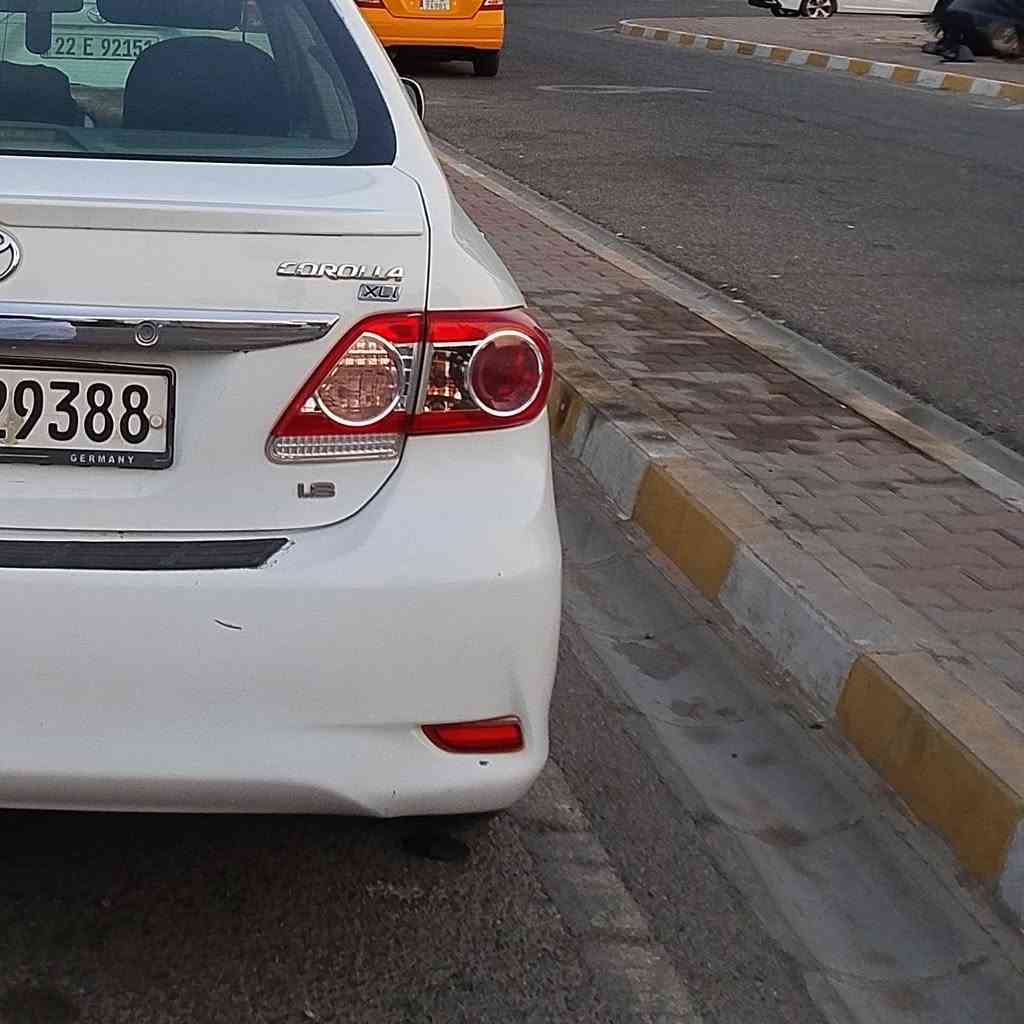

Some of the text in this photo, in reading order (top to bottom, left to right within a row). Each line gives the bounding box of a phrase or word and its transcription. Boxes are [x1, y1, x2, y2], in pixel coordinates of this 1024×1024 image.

[56, 37, 75, 55] 22
[83, 38, 94, 55] E
[276, 261, 404, 282] COROLLA
[70, 453, 134, 464] GERMANY
